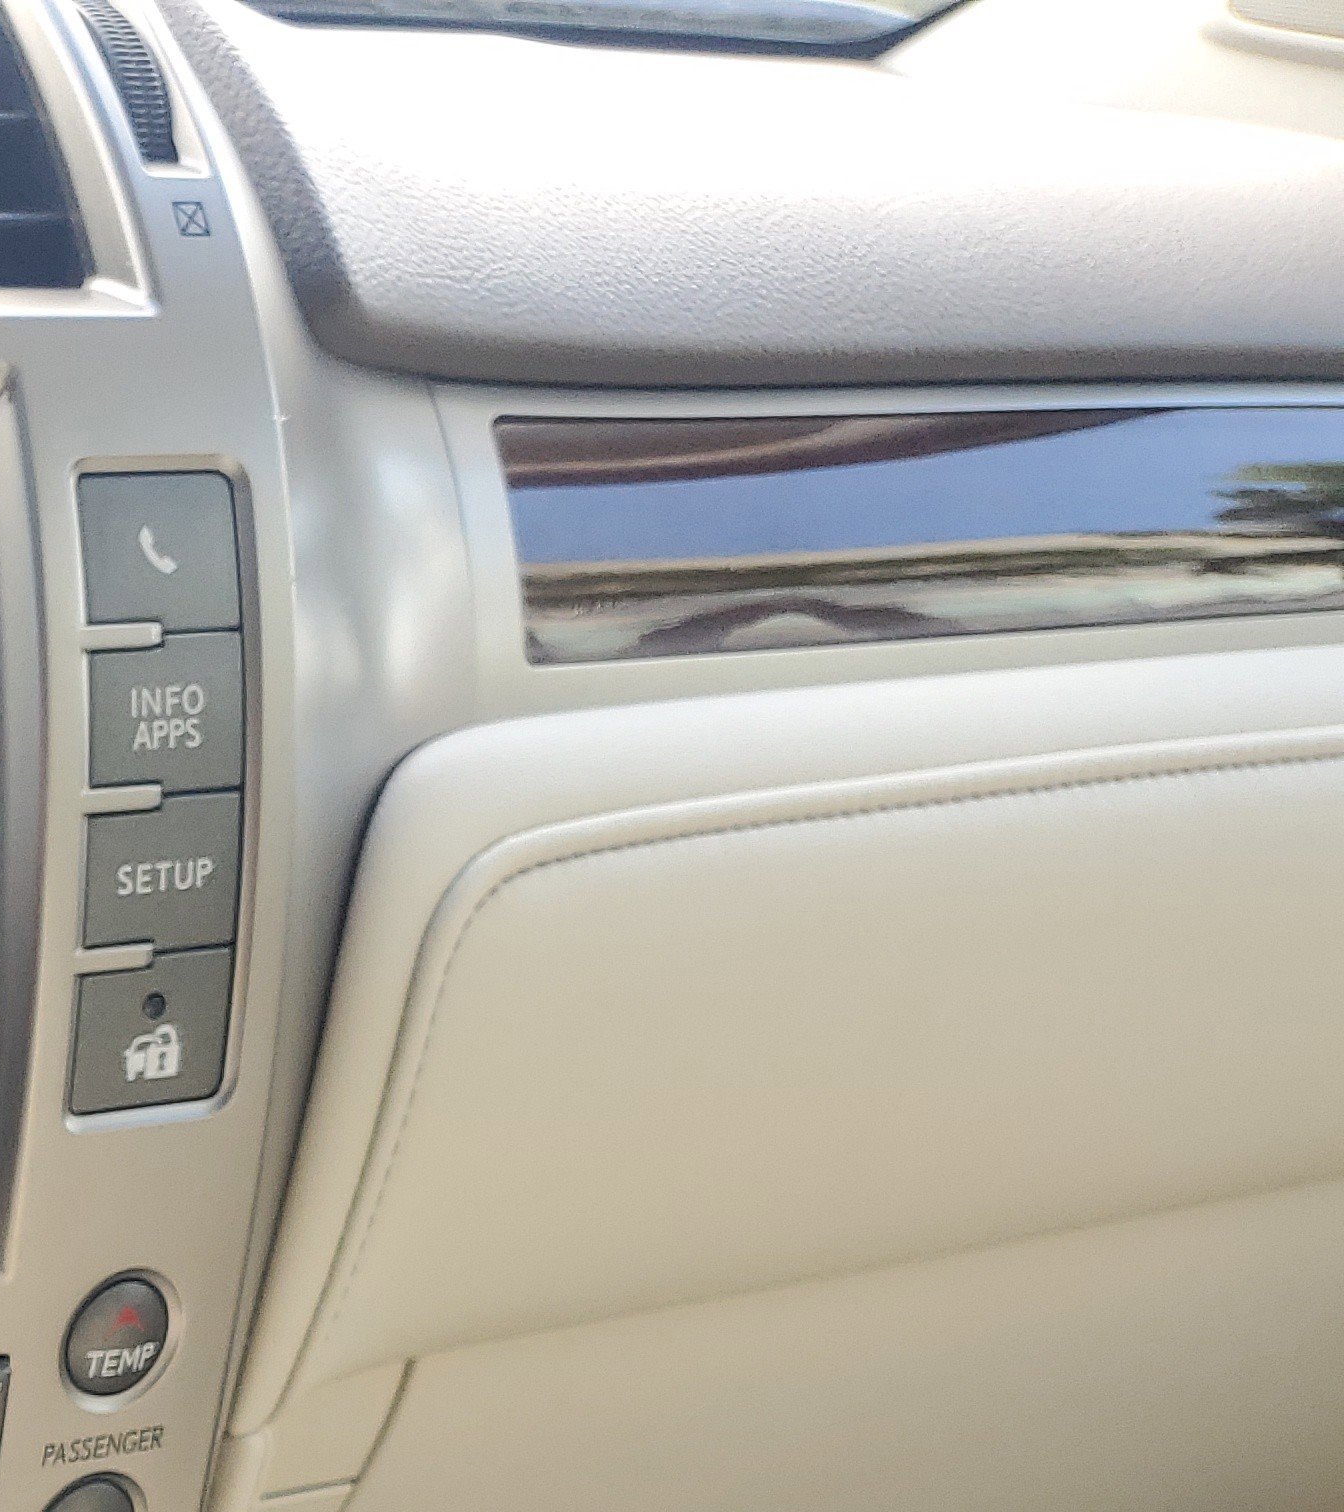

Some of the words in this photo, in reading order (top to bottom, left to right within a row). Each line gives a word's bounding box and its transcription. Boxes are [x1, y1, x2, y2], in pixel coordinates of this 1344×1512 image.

[130, 684, 205, 719] INFO
[132, 719, 204, 751] APPS
[116, 856, 214, 897] SETUP
[84, 1341, 160, 1379] TEMP
[41, 1425, 165, 1467] PASSENGER
